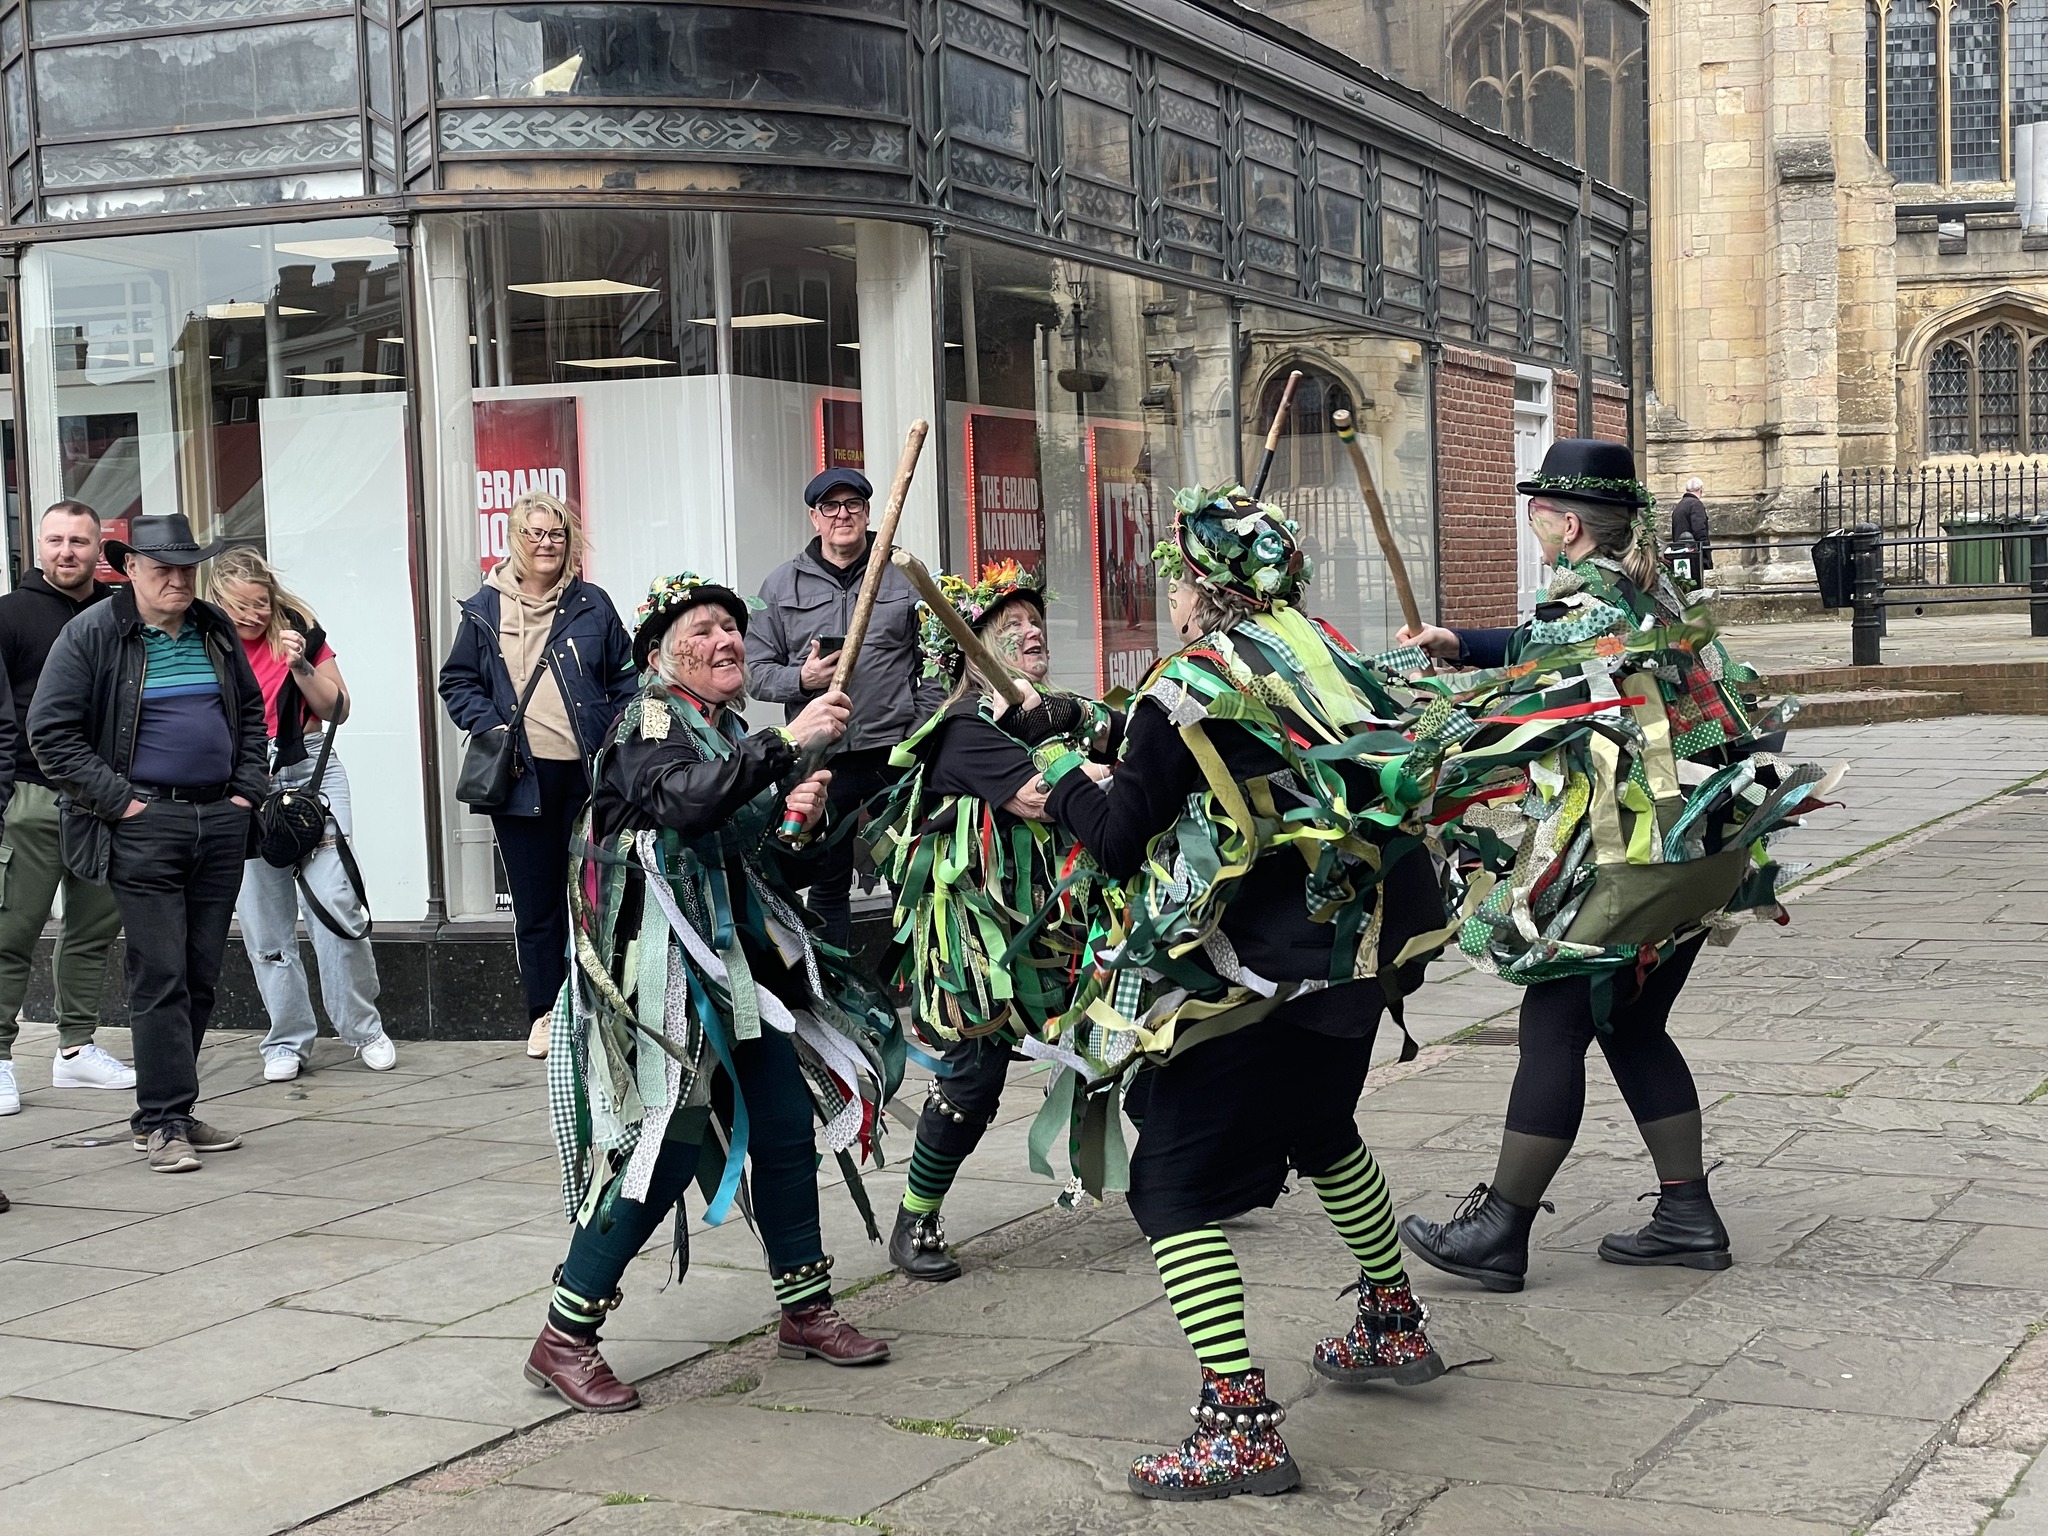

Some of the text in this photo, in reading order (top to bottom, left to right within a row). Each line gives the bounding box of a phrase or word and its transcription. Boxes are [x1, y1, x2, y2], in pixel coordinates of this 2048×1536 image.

[833, 448, 846, 459] THE
[476, 468, 566, 509] GRAND
[981, 475, 1038, 510] THE GRAND
[982, 512, 1040, 550] NATIONAL
